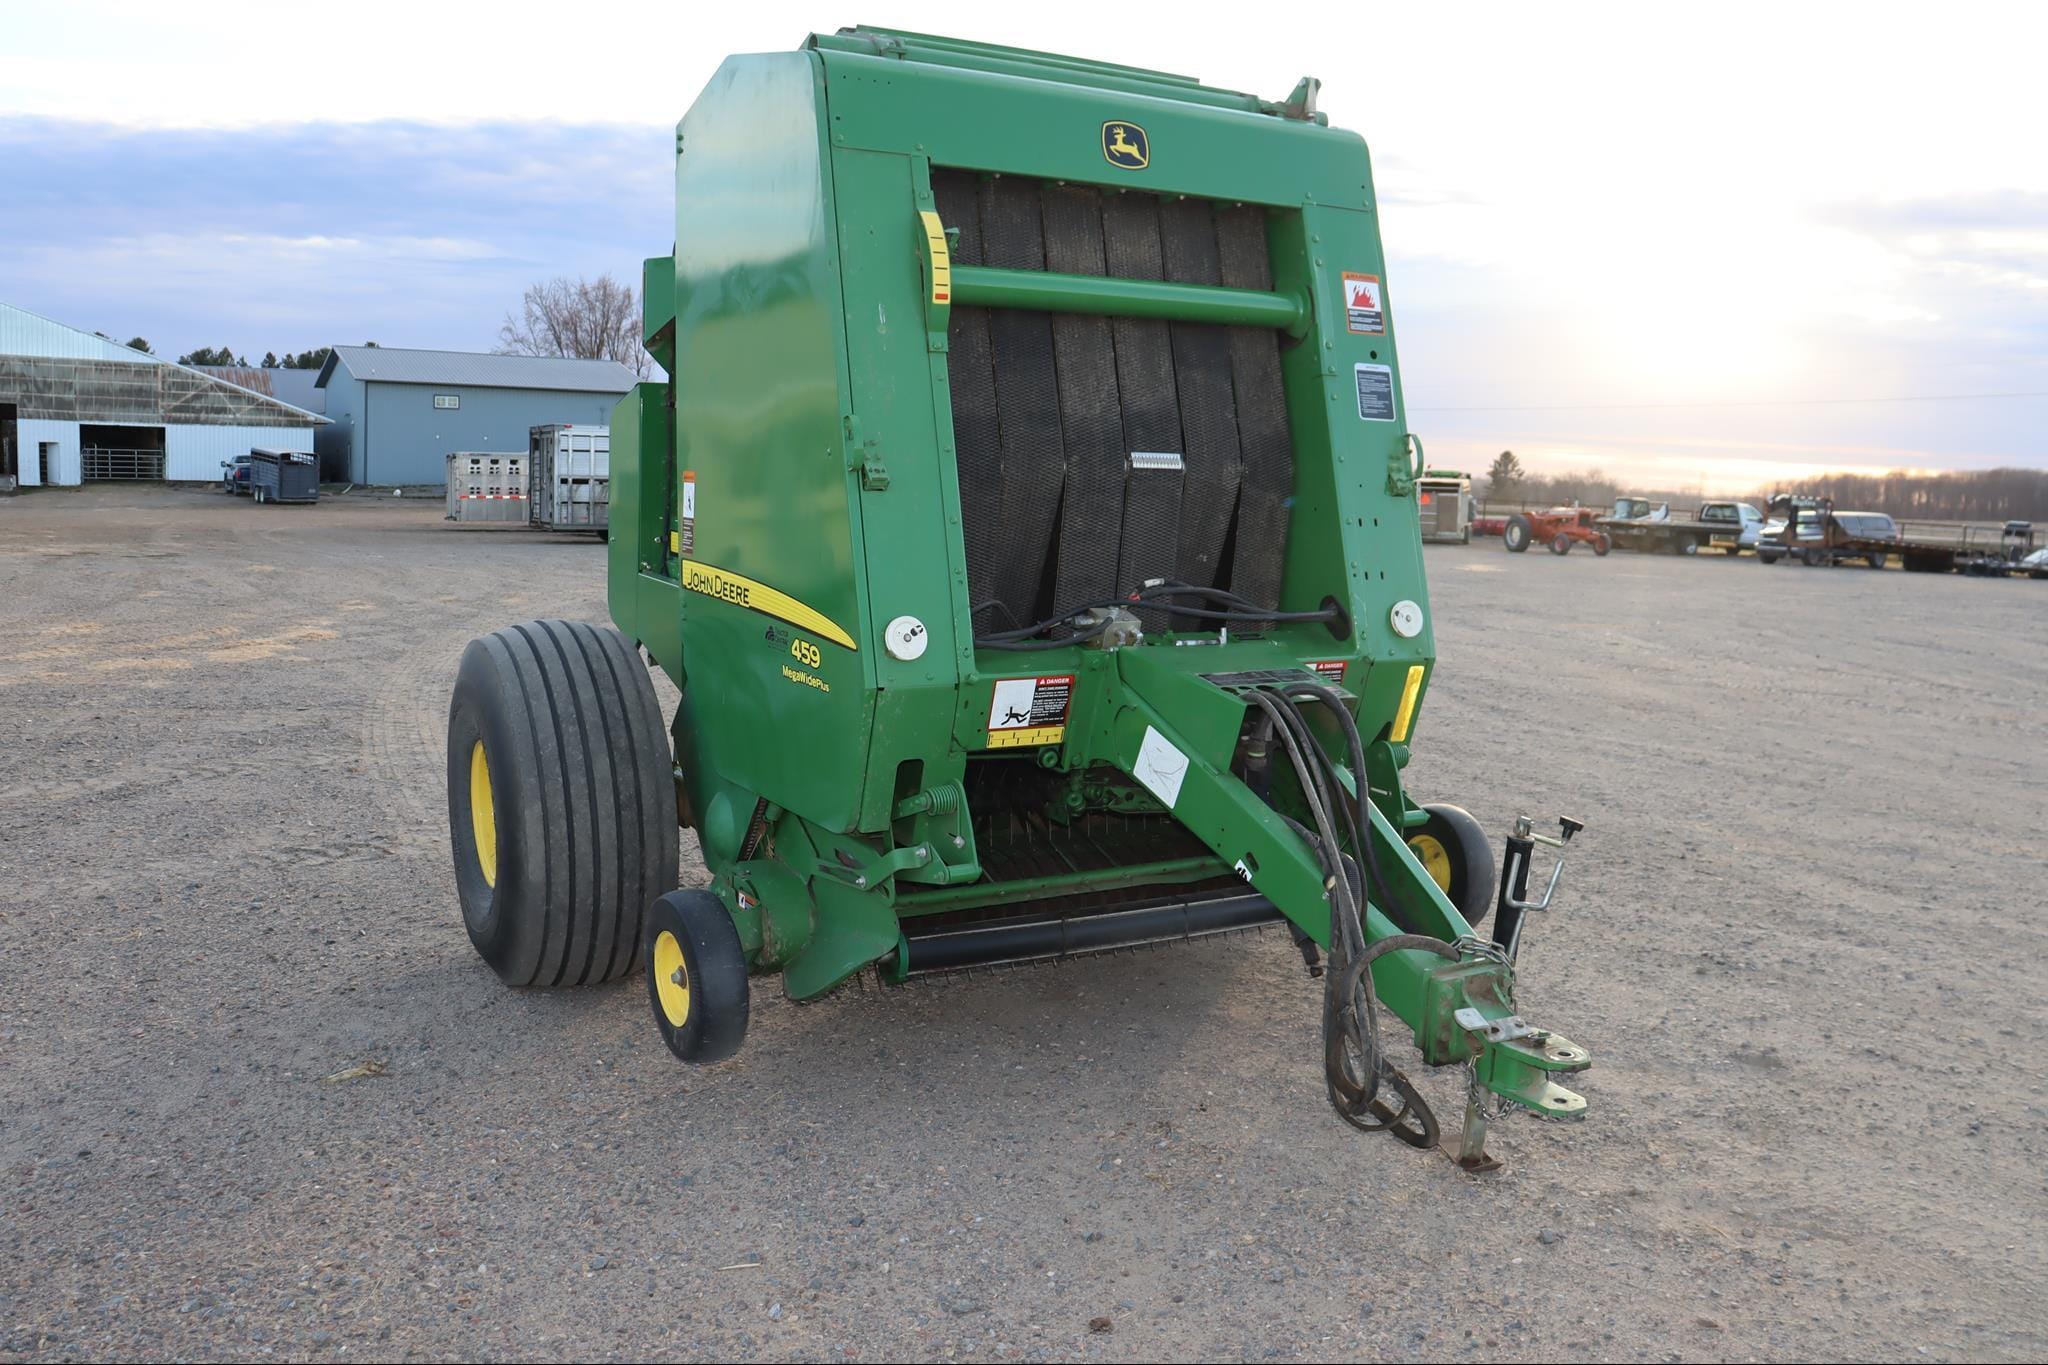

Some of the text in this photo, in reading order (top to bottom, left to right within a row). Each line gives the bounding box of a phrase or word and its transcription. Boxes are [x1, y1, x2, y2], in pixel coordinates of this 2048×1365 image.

[687, 568, 750, 604] JOHN DEERE
[791, 638, 821, 668] 459
[782, 664, 830, 692] MegaWidePlus
